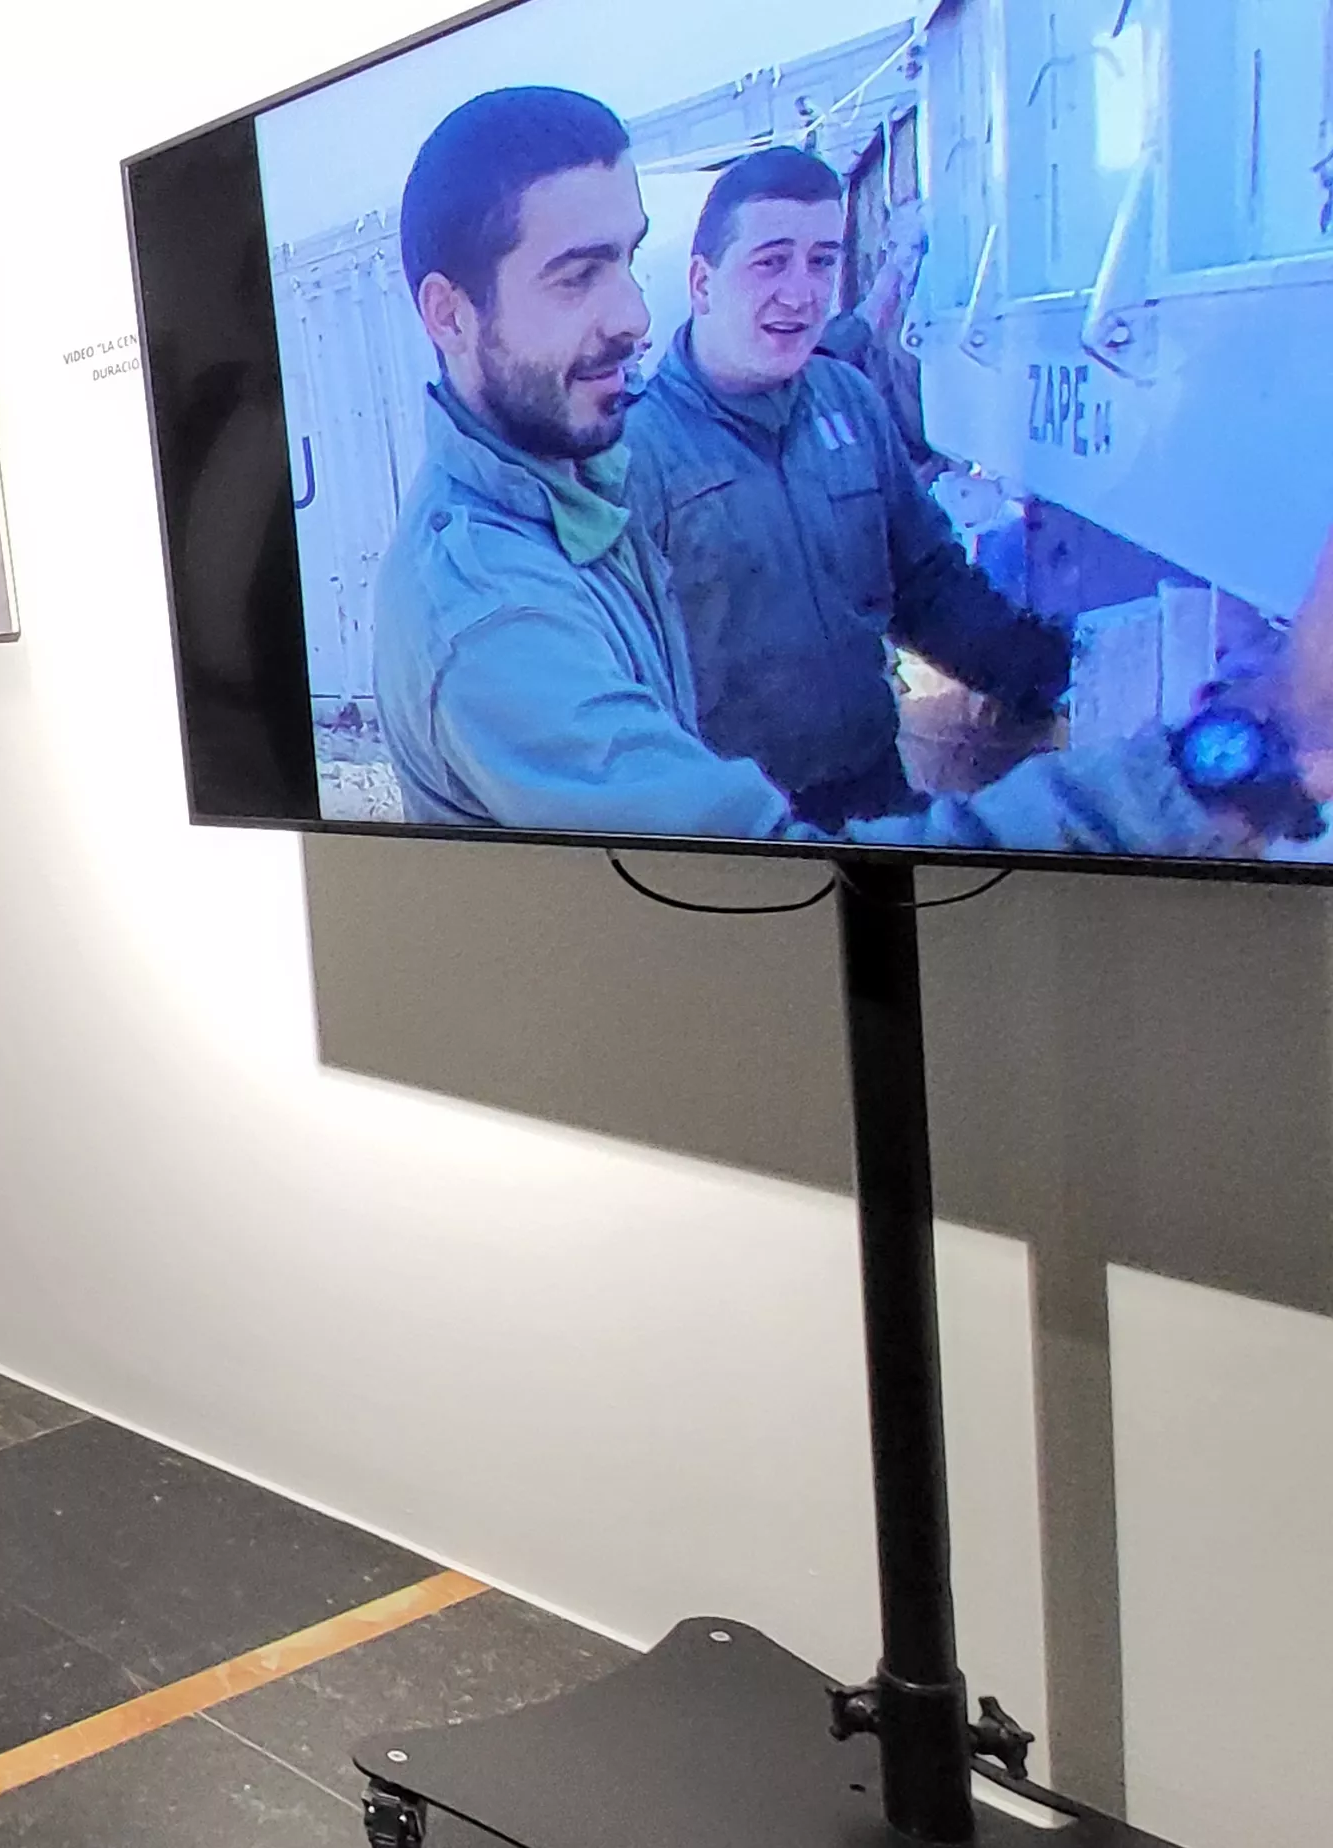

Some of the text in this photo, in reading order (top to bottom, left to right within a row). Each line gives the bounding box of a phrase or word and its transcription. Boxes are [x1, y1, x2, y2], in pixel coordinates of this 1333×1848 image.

[63, 345, 94, 365] VIDEO
[117, 334, 138, 348] CEN
[92, 357, 140, 381] DURACIO
[1028, 364, 1088, 457] ZAPE
